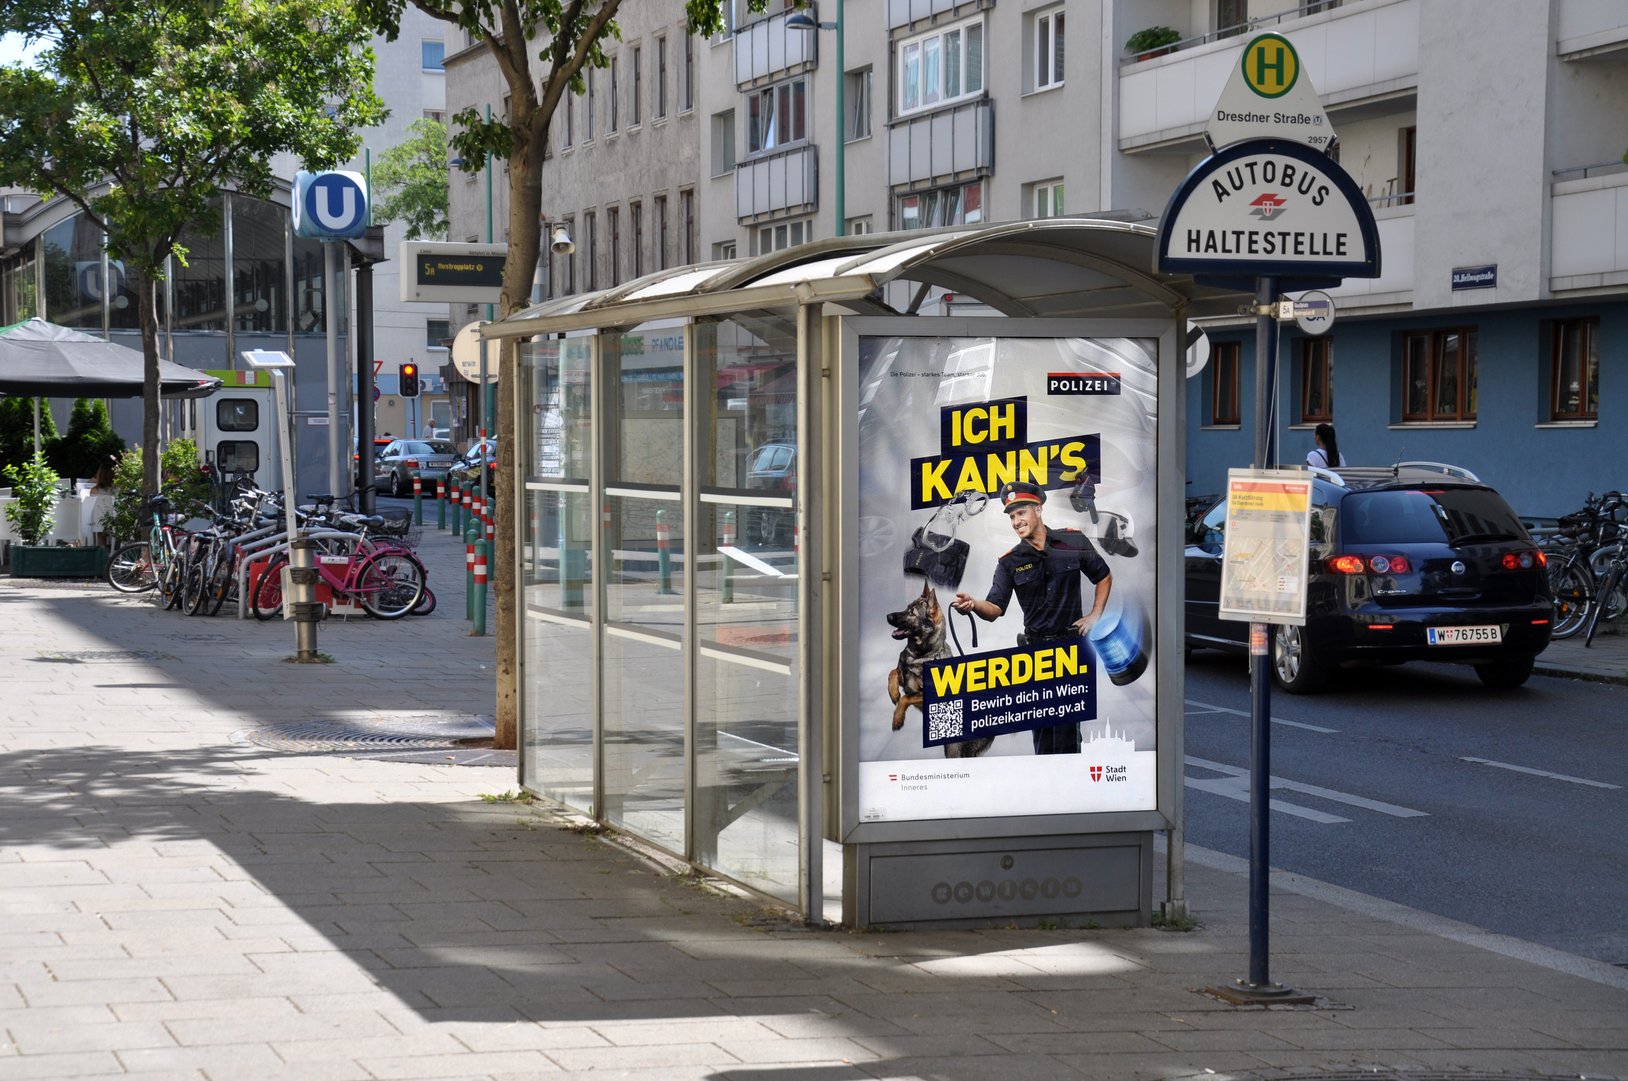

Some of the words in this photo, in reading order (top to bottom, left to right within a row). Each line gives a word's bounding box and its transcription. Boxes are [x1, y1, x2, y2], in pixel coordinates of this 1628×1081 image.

[1257, 47, 1284, 86] H
[1217, 110, 1270, 122] Dresdner
[1273, 112, 1311, 125] Straße
[1308, 136, 1328, 144] 2957
[1211, 160, 1330, 206] AUTOBUS
[315, 186, 355, 229] U
[1187, 229, 1347, 256] HALTESTELLE
[1051, 381, 1108, 391] POLIZEI
[951, 403, 1015, 447] ICH
[930, 644, 1088, 697] WERDEN.
[971, 693, 1013, 712] Bewirb
[1015, 689, 1039, 704] dich
[1042, 688, 1053, 699] in
[1055, 684, 1089, 697] Wien:
[971, 700, 1086, 732] polizeikarriere.gv.at
[901, 772, 970, 781] Bundesministerium
[1105, 765, 1127, 774] Stadt
[1105, 774, 1127, 782] Wien
